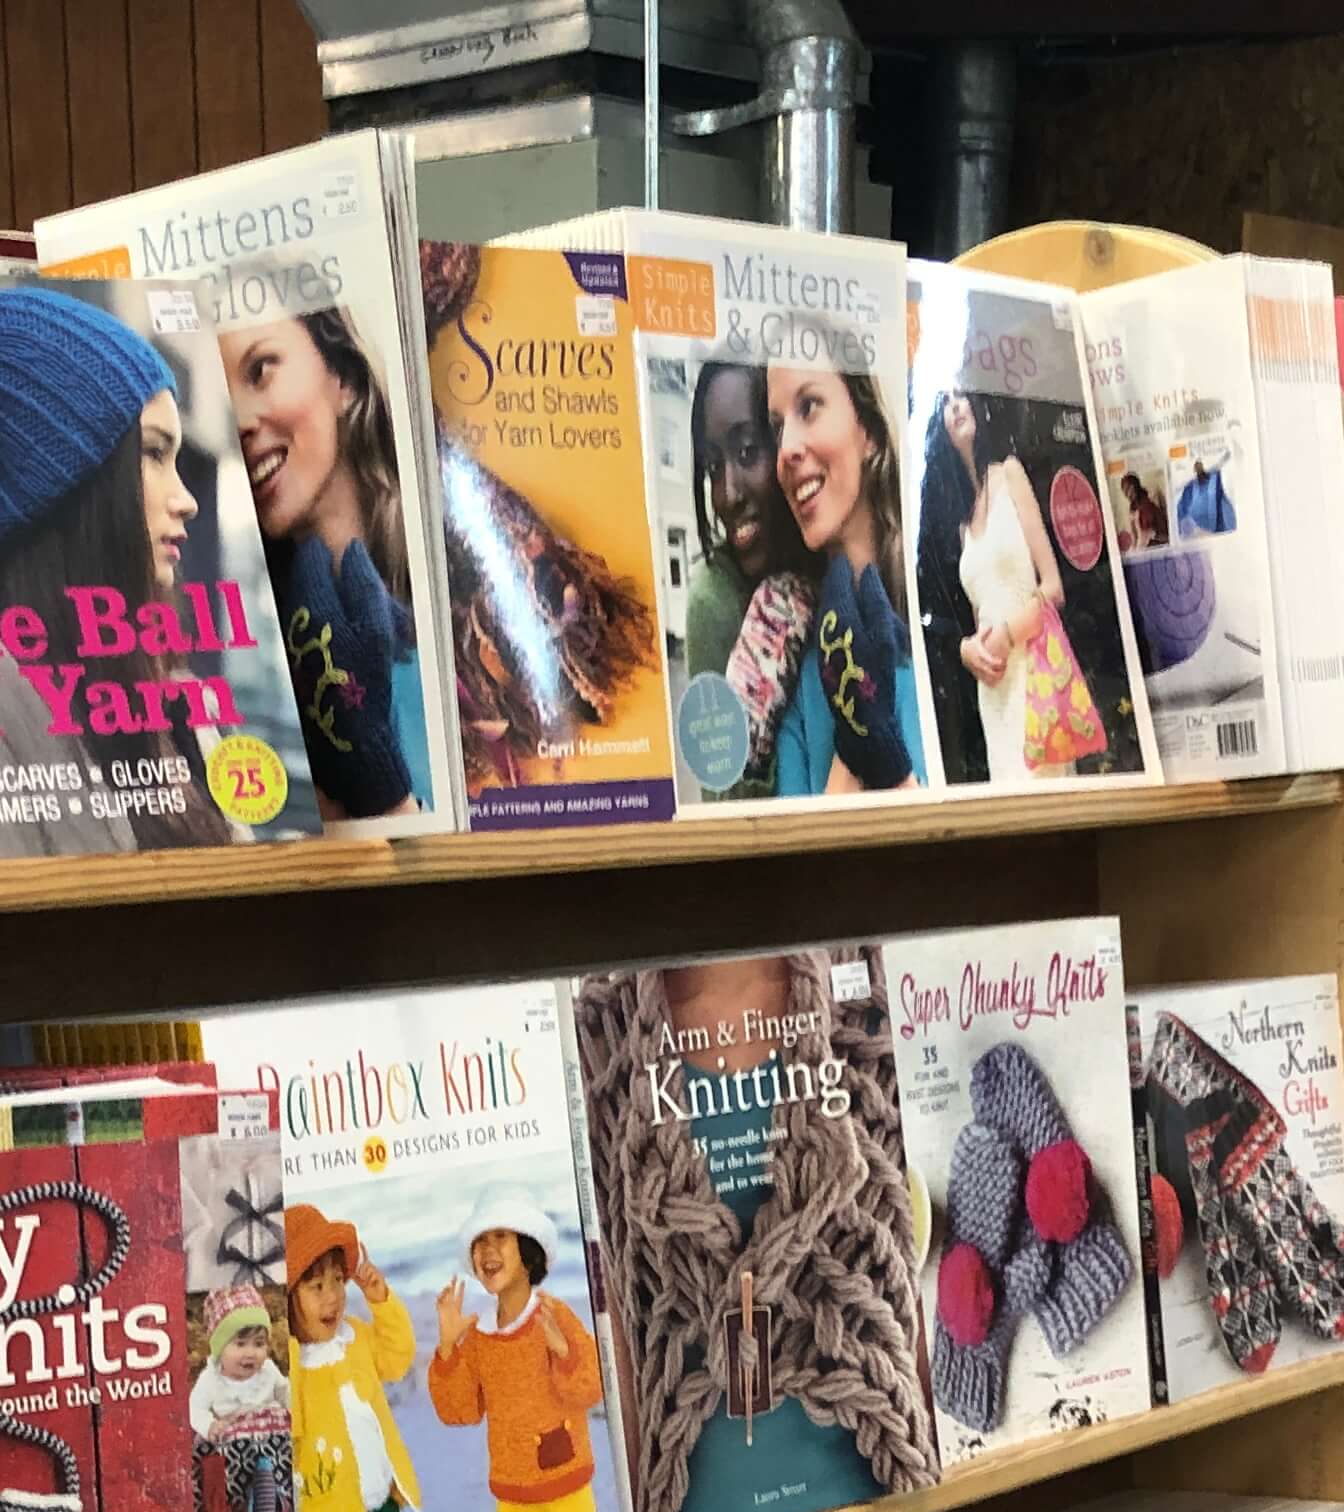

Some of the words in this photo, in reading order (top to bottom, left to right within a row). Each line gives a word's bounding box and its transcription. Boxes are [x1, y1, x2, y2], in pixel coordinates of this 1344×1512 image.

[137, 195, 314, 277] Mittens
[641, 263, 711, 295] Simple
[644, 300, 715, 333] Knits
[447, 300, 615, 406] Scarves
[727, 314, 751, 353] &
[759, 314, 877, 367] Gloves
[495, 386, 539, 412] and
[542, 386, 619, 416] Shawls
[64, 579, 258, 658] Ball
[24, 663, 248, 737] Yarn
[111, 756, 191, 787] GLOVES
[90, 787, 188, 817] SLIPPERS
[900, 972, 952, 1040] Super
[958, 960, 1047, 1031] Chunky
[1032, 951, 1109, 1019] Knits
[657, 1023, 709, 1056] Arm
[716, 1020, 736, 1047] &
[743, 1006, 823, 1049] Finger
[1219, 1004, 1305, 1051] Northern
[439, 1036, 527, 1117] Knits
[921, 1043, 939, 1066] 35
[1280, 1039, 1338, 1080] Knits
[644, 1048, 852, 1128] Knitting
[1283, 1080, 1328, 1125] Gifts
[65, 1384, 102, 1408] the
[107, 1374, 173, 1403] World
